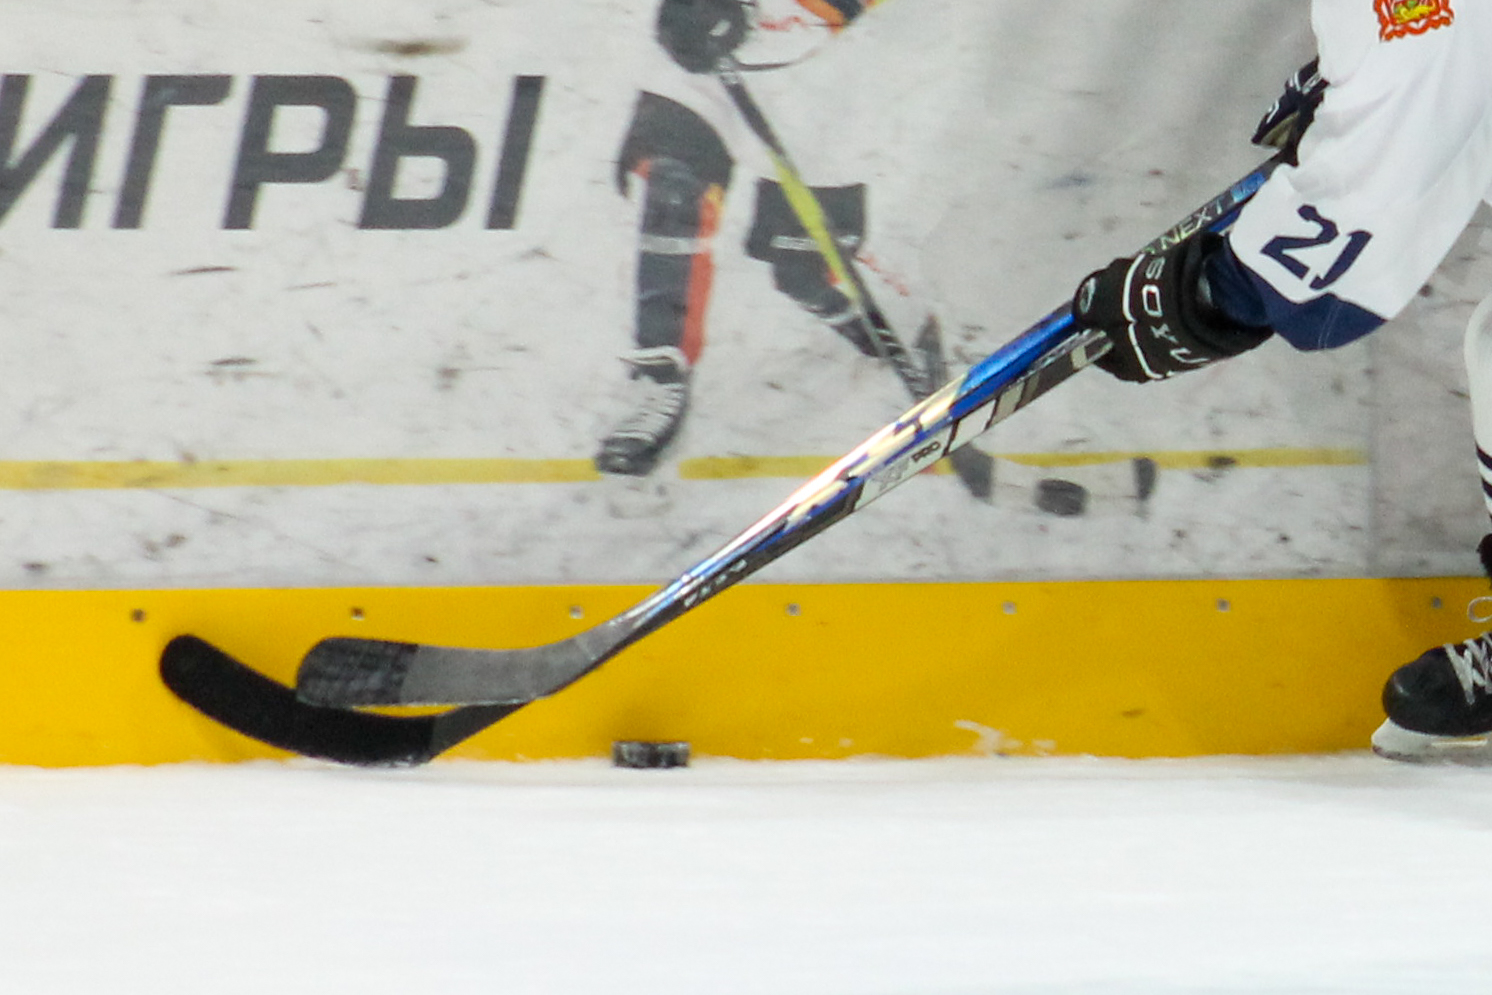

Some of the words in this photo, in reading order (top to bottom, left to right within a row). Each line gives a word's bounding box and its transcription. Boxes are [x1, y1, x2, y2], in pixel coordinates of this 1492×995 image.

[0, 74, 547, 230] ИГРЫ
[1259, 204, 1373, 290] 21
[910, 440, 942, 463] PRO
